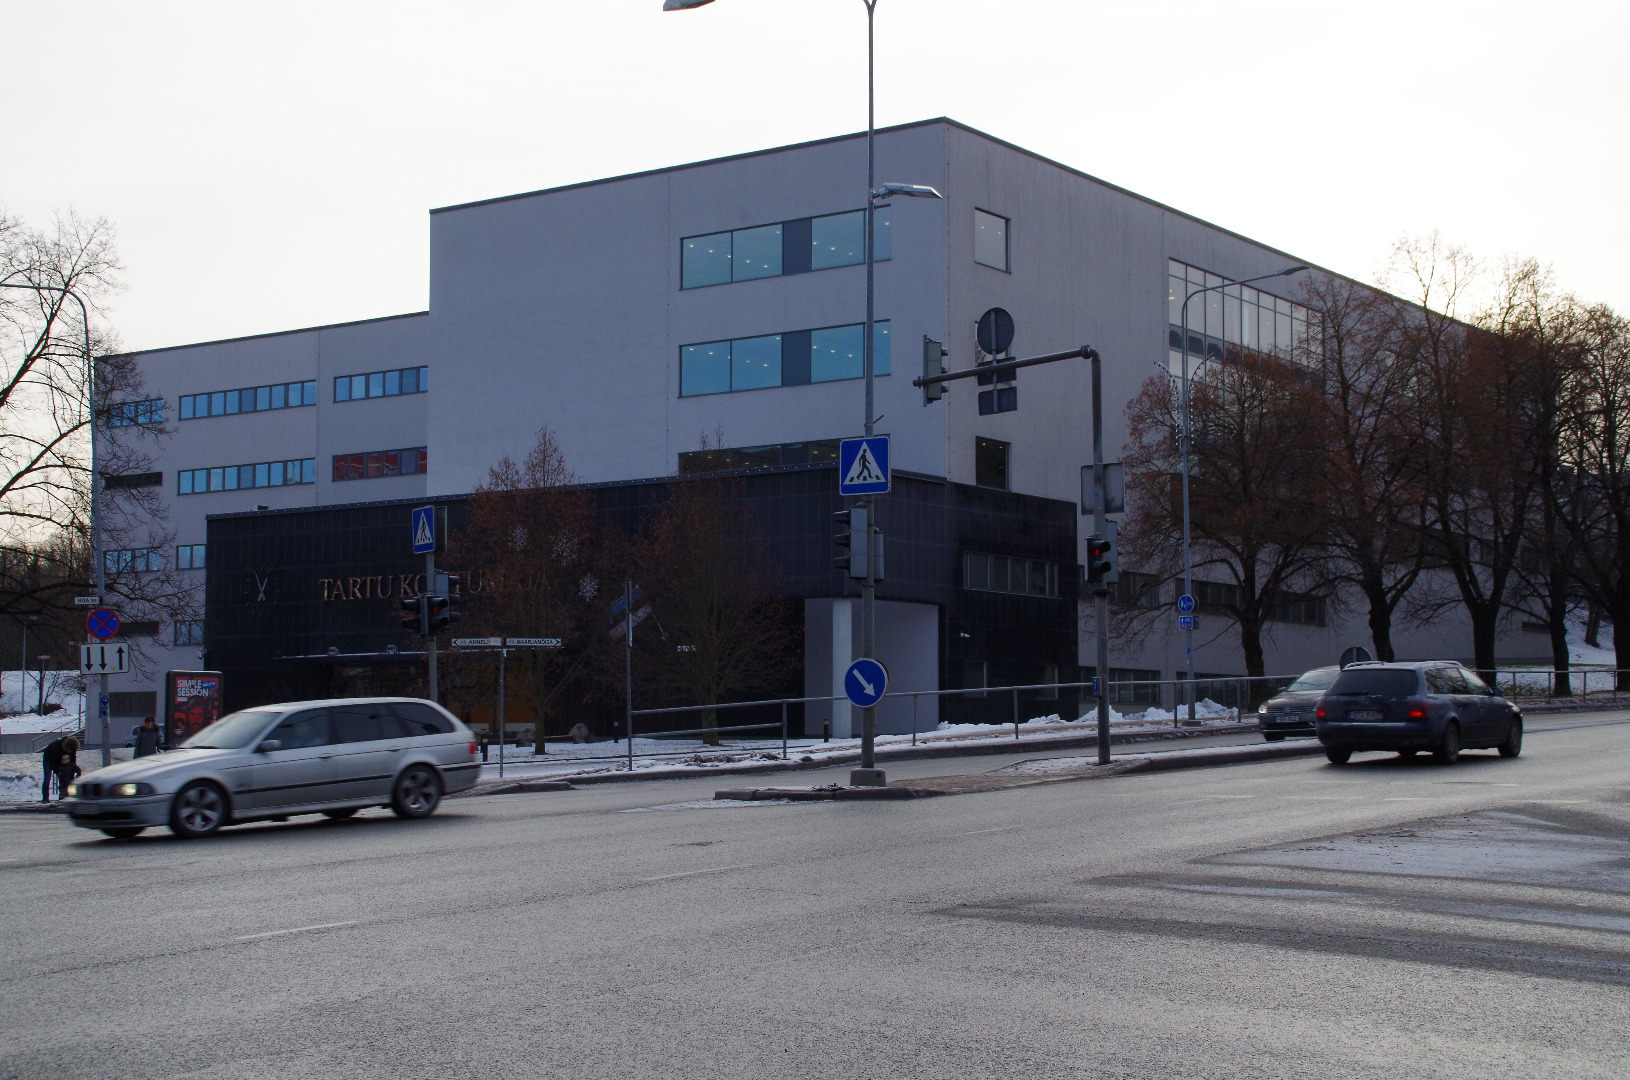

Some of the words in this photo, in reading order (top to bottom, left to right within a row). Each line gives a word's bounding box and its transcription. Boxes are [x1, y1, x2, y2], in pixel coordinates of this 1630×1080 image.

[319, 575, 394, 601] TARTU
[177, 679, 202, 689] SIMPLE
[177, 687, 209, 697] SESSION
